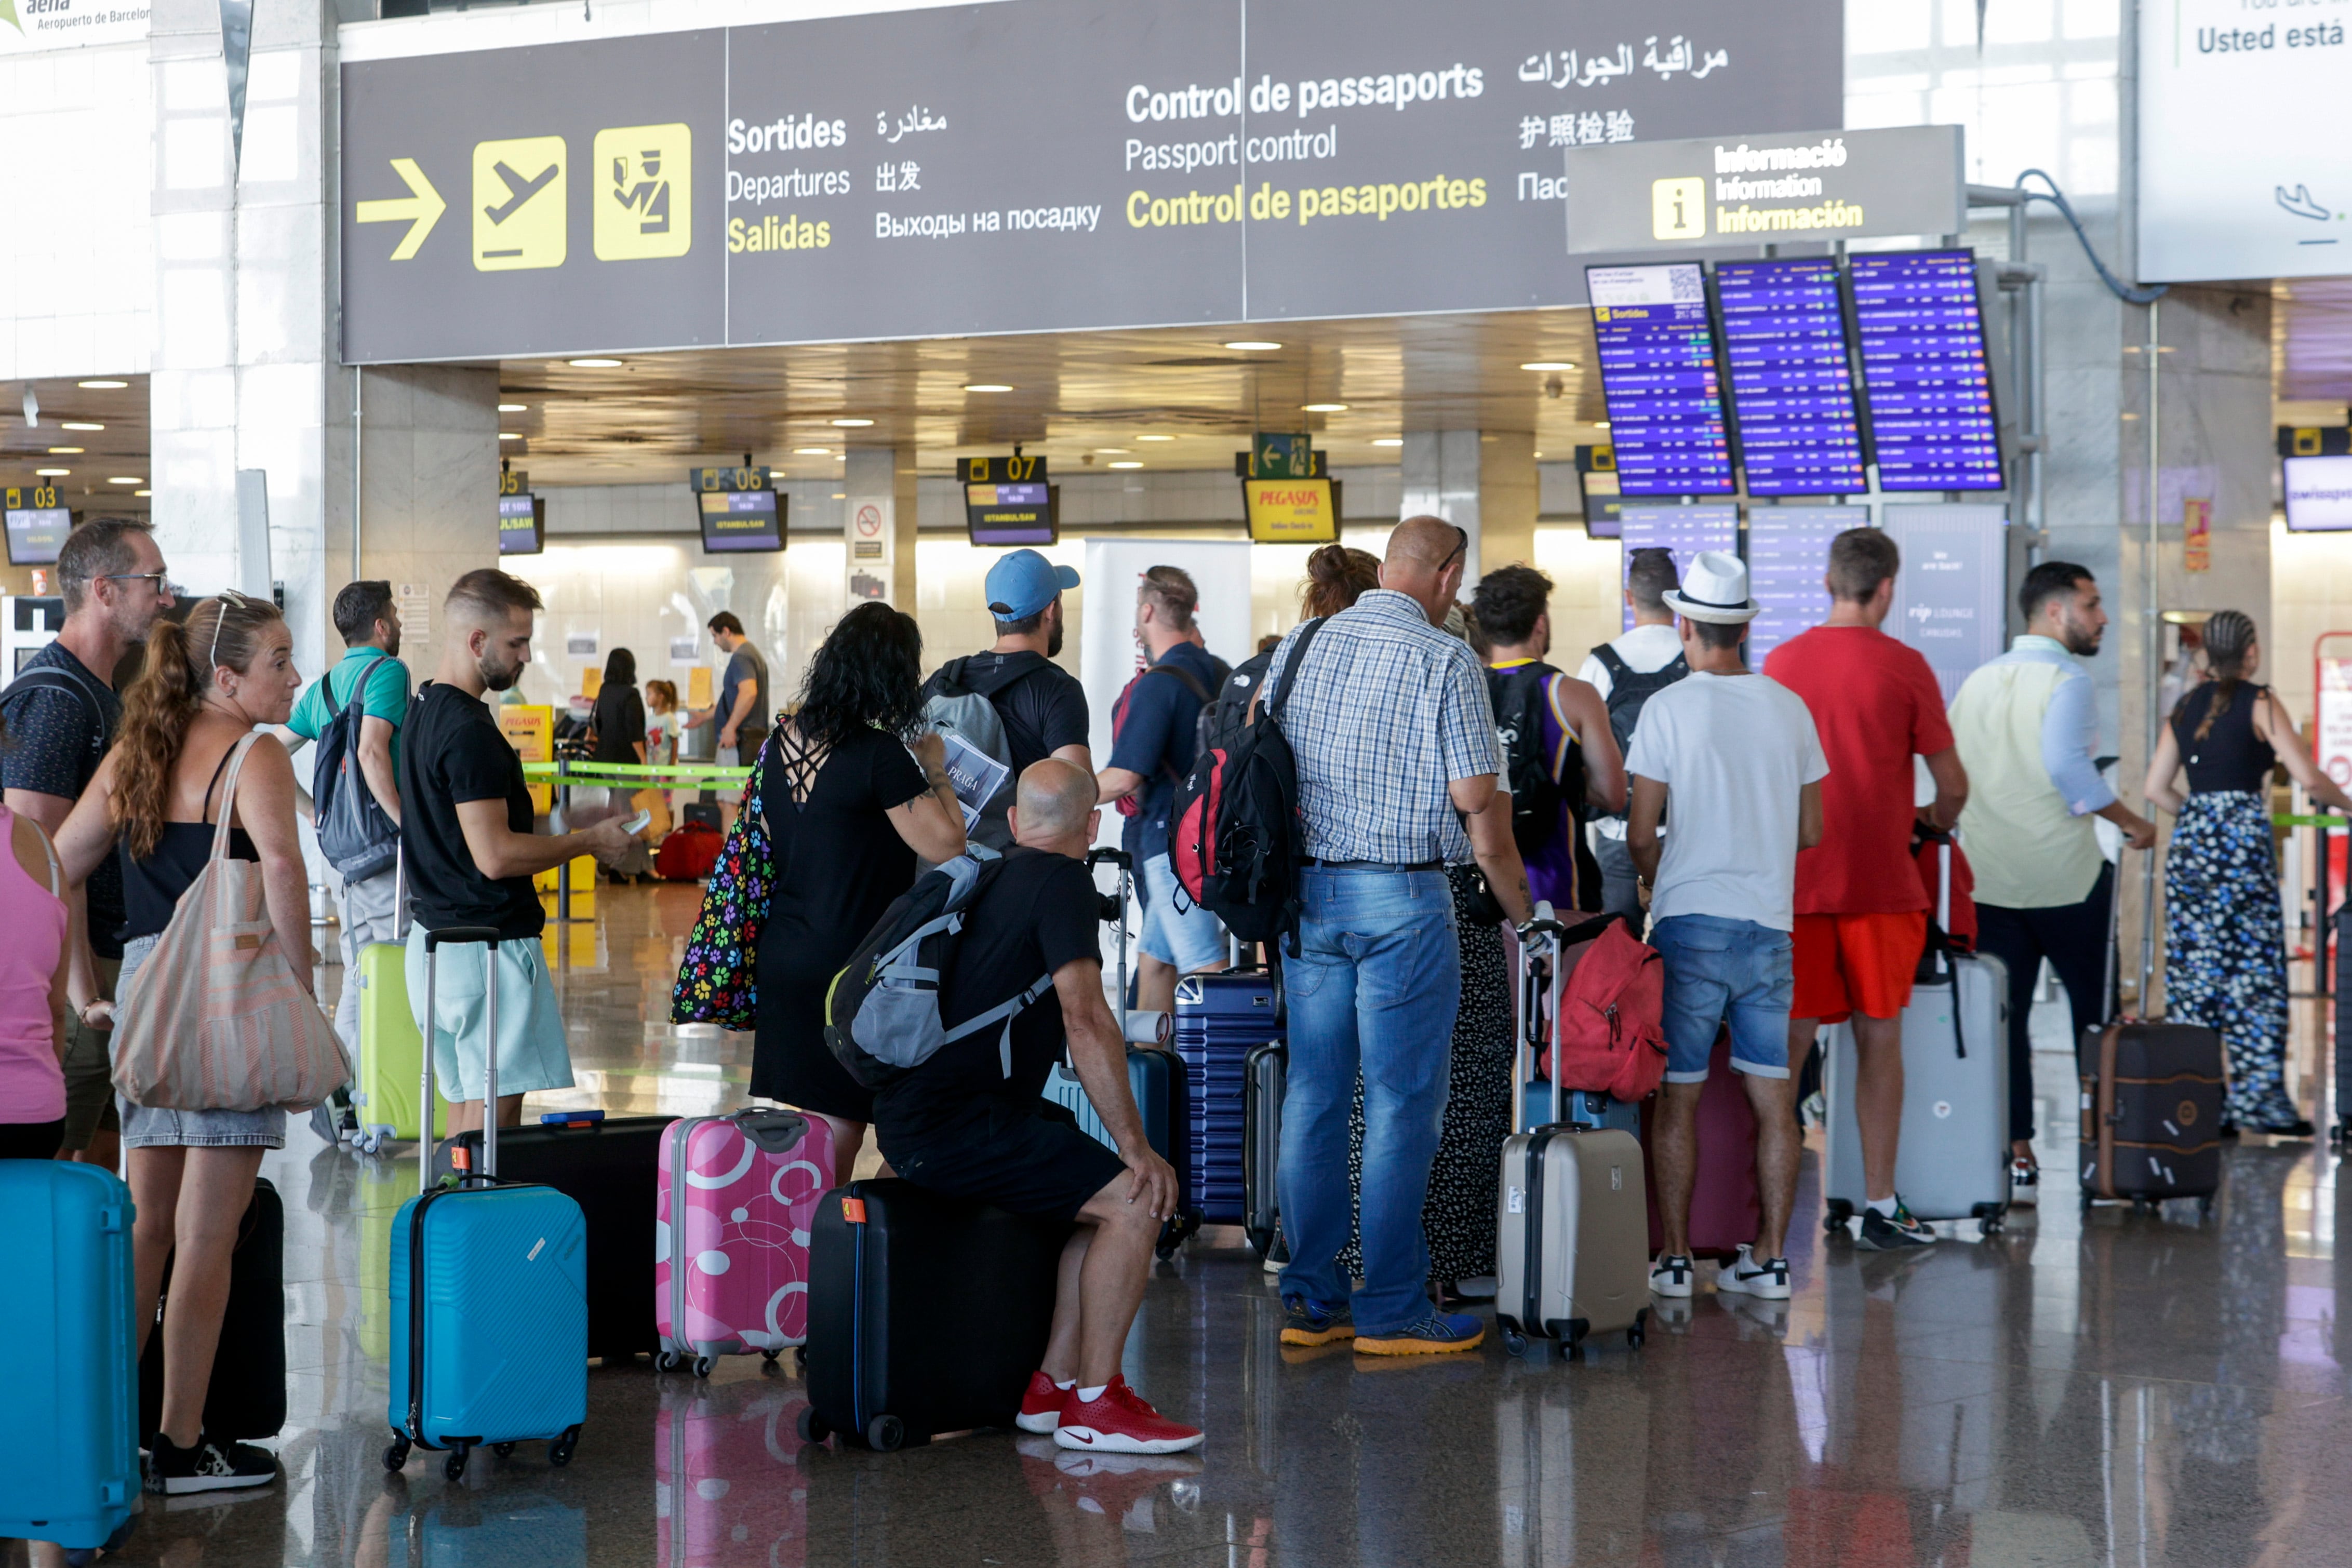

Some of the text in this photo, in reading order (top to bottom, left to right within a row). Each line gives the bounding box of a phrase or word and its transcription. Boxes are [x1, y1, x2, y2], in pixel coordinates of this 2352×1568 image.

[37, 15, 92, 30] Aeropuerto
[95, 11, 107, 24] de
[2198, 18, 2344, 53] Usted está
[1518, 35, 1728, 89] مراقبة الجوازات
[1126, 63, 1484, 123] Control de passaports
[727, 113, 847, 155] Sortides
[876, 104, 947, 143] مغادرة
[1519, 110, 1635, 150] 护照检验
[1125, 124, 1337, 174] Passport control
[1714, 138, 1848, 174] Informació
[727, 167, 851, 206] Departures
[876, 160, 921, 192] 出发
[1715, 172, 1822, 201] Information
[1126, 173, 1487, 229] Control de pasaportes
[1716, 198, 1864, 234] Información
[727, 214, 831, 254] Salidas
[876, 204, 1102, 239] Выходы на посадку
[736, 467, 762, 490] 06
[1007, 456, 1037, 481] 07
[34, 486, 56, 508] 03
[1259, 489, 1319, 507] PEGASUS
[947, 766, 978, 791] PRAGA
